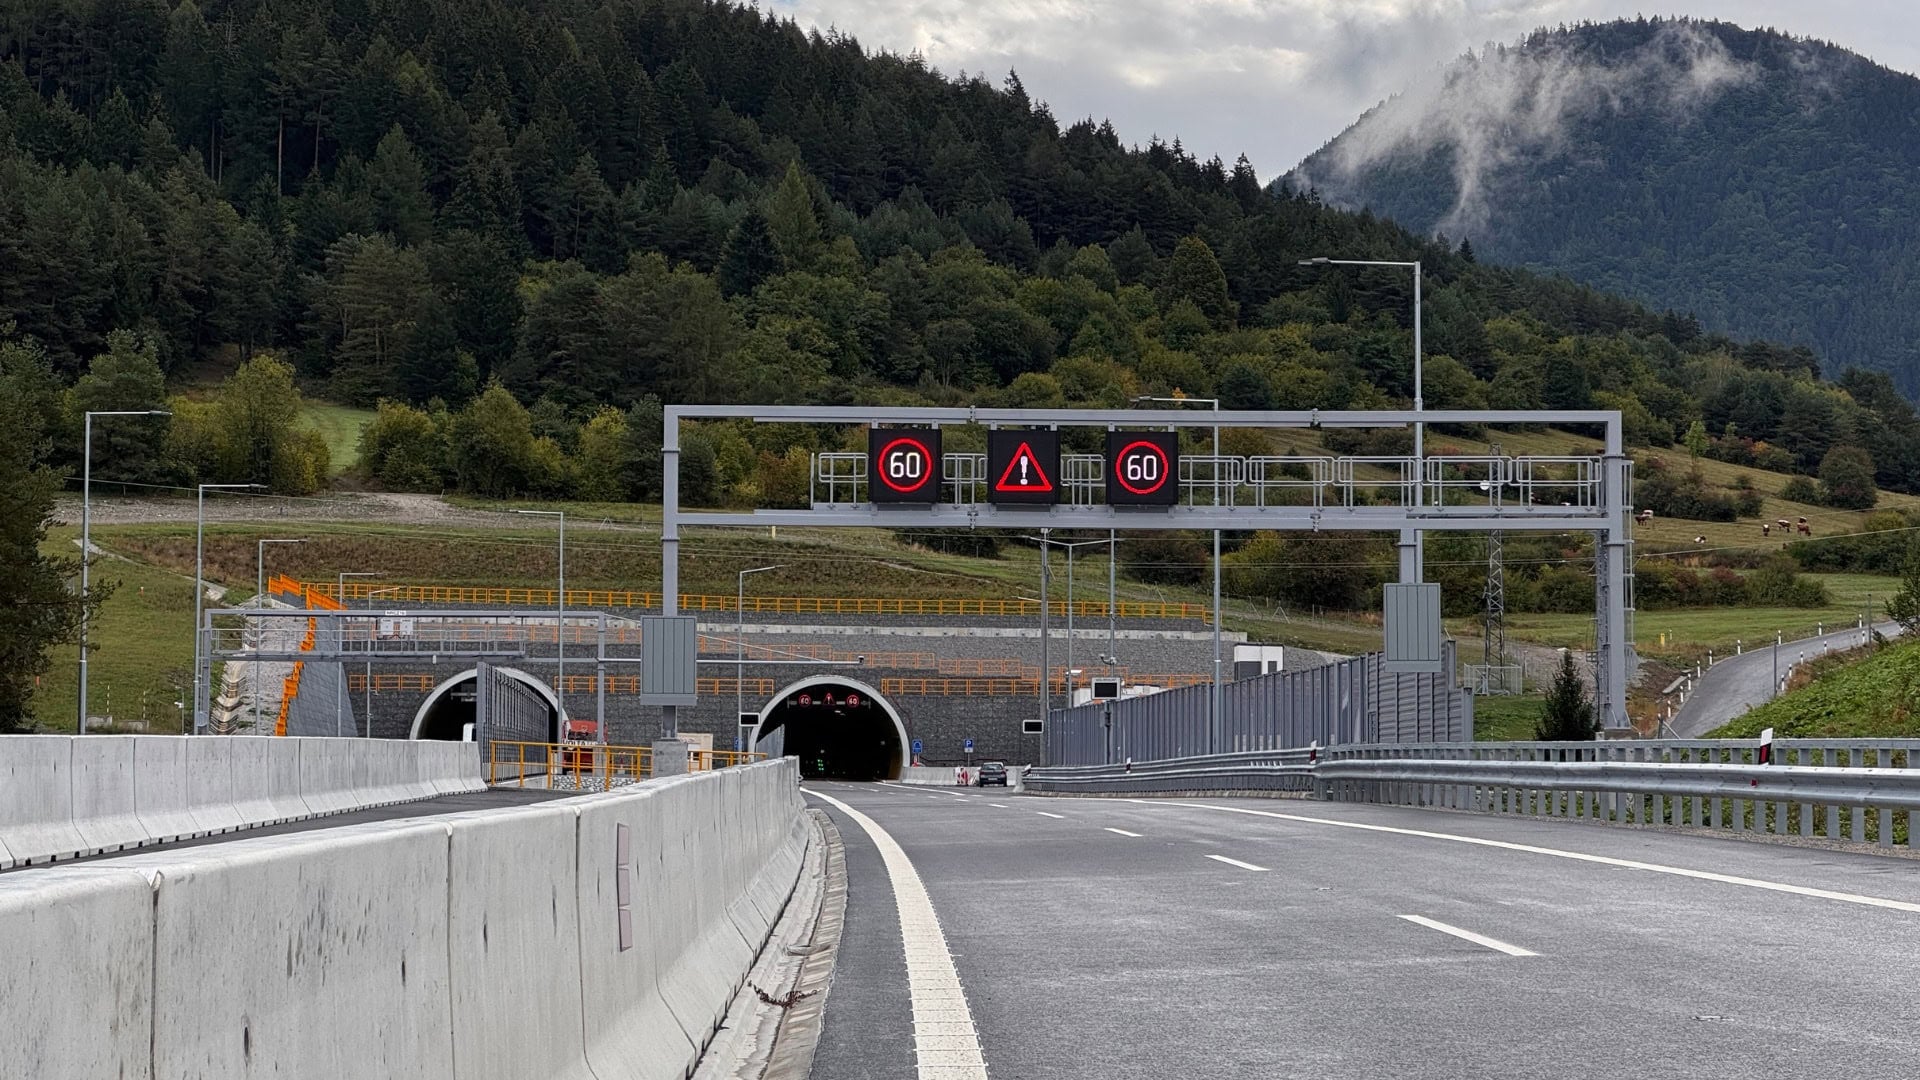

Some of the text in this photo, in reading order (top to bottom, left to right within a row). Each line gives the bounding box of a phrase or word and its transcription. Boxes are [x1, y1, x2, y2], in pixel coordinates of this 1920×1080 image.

[890, 452, 921, 478] 60
[1127, 455, 1157, 480] 60
[800, 697, 809, 705] 60
